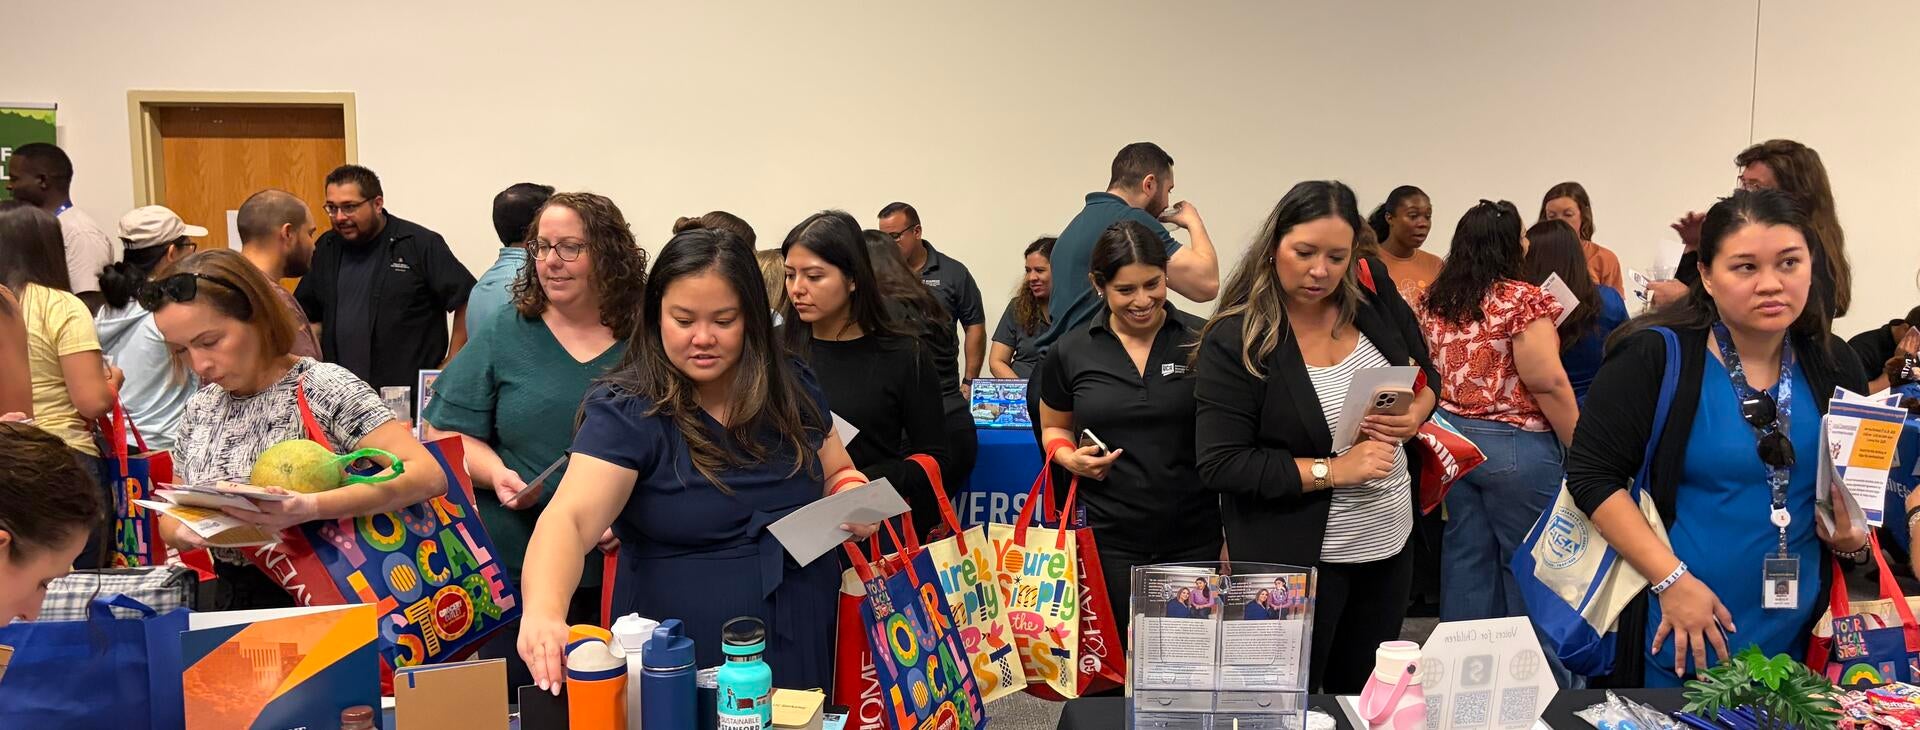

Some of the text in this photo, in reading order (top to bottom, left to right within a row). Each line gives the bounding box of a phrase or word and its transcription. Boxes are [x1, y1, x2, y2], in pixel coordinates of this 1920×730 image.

[346, 521, 492, 620] LOCAL
[872, 582, 952, 682] YOUR
[1011, 615, 1039, 632] the
[1834, 617, 1863, 632] YOUR
